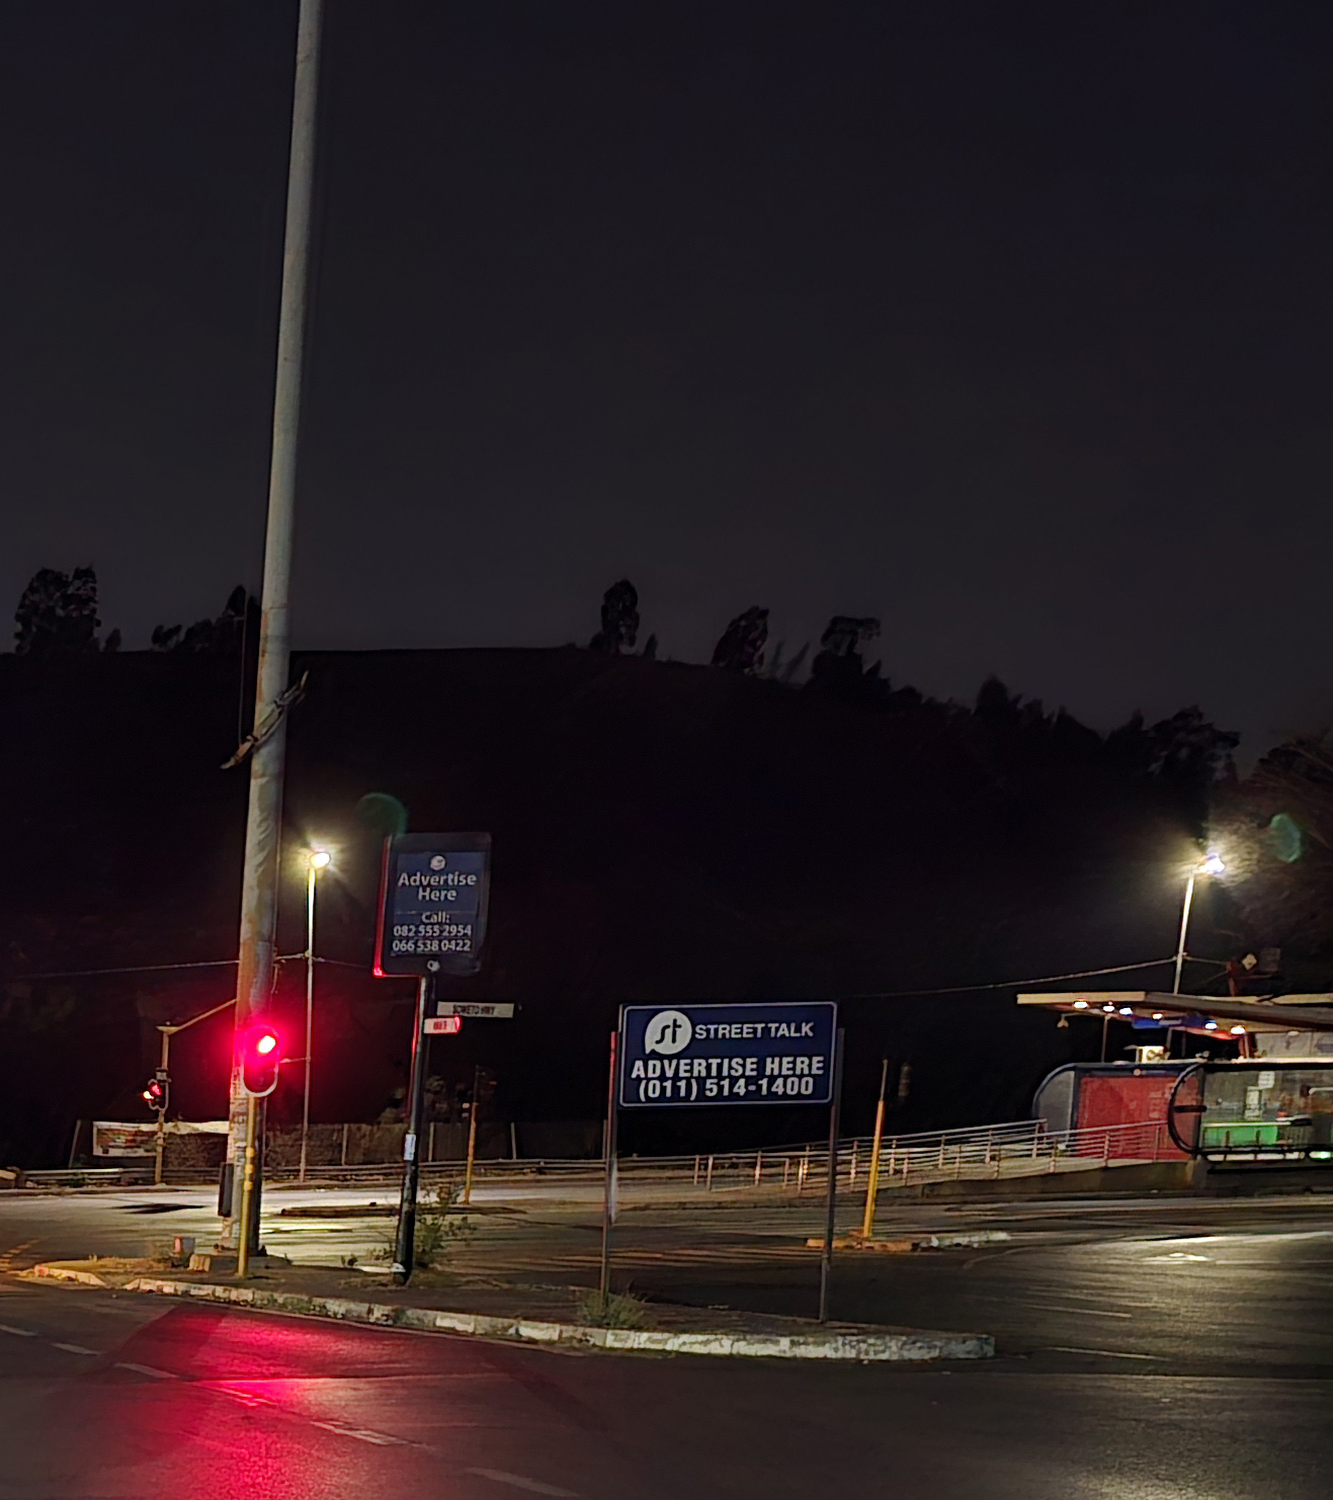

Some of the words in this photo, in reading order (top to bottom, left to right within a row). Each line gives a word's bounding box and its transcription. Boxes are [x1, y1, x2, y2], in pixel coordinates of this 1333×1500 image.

[397, 871, 477, 887] Advertise
[417, 887, 457, 901] Here
[421, 911, 450, 923] Call:
[393, 925, 416, 937] 082
[417, 925, 440, 937] 555
[442, 924, 472, 937] 2954
[392, 940, 415, 952] 066
[417, 940, 439, 952] 538
[441, 940, 471, 952] 0422
[694, 1023, 766, 1040] STREET
[767, 1021, 815, 1038] TALK
[631, 1057, 759, 1079] ADVERTISE
[764, 1056, 825, 1077] HERE
[639, 1078, 698, 1102] (011)
[704, 1076, 814, 1098] 514-1400
